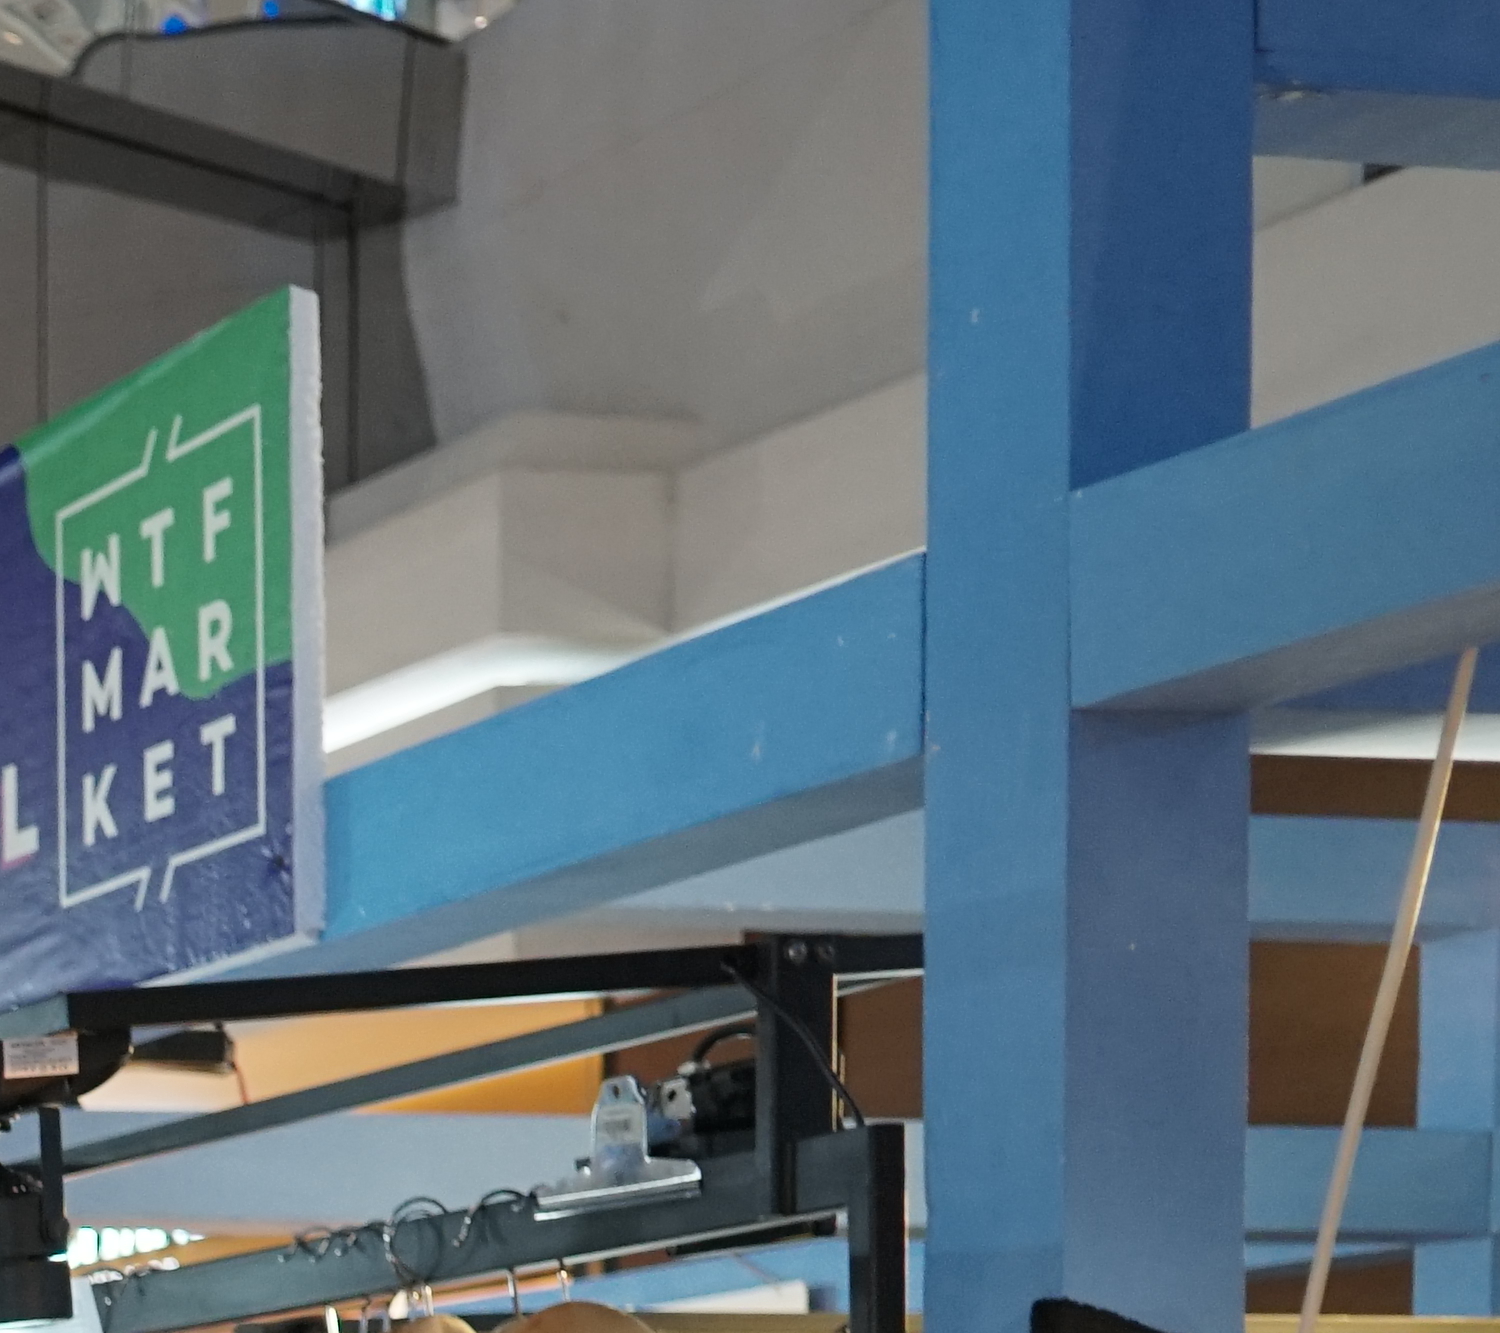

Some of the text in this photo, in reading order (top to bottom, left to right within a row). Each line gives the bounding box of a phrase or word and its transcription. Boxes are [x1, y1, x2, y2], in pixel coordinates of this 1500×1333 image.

[81, 476, 234, 621] WTF
[82, 601, 234, 733] MAR
[83, 714, 238, 847] KET
